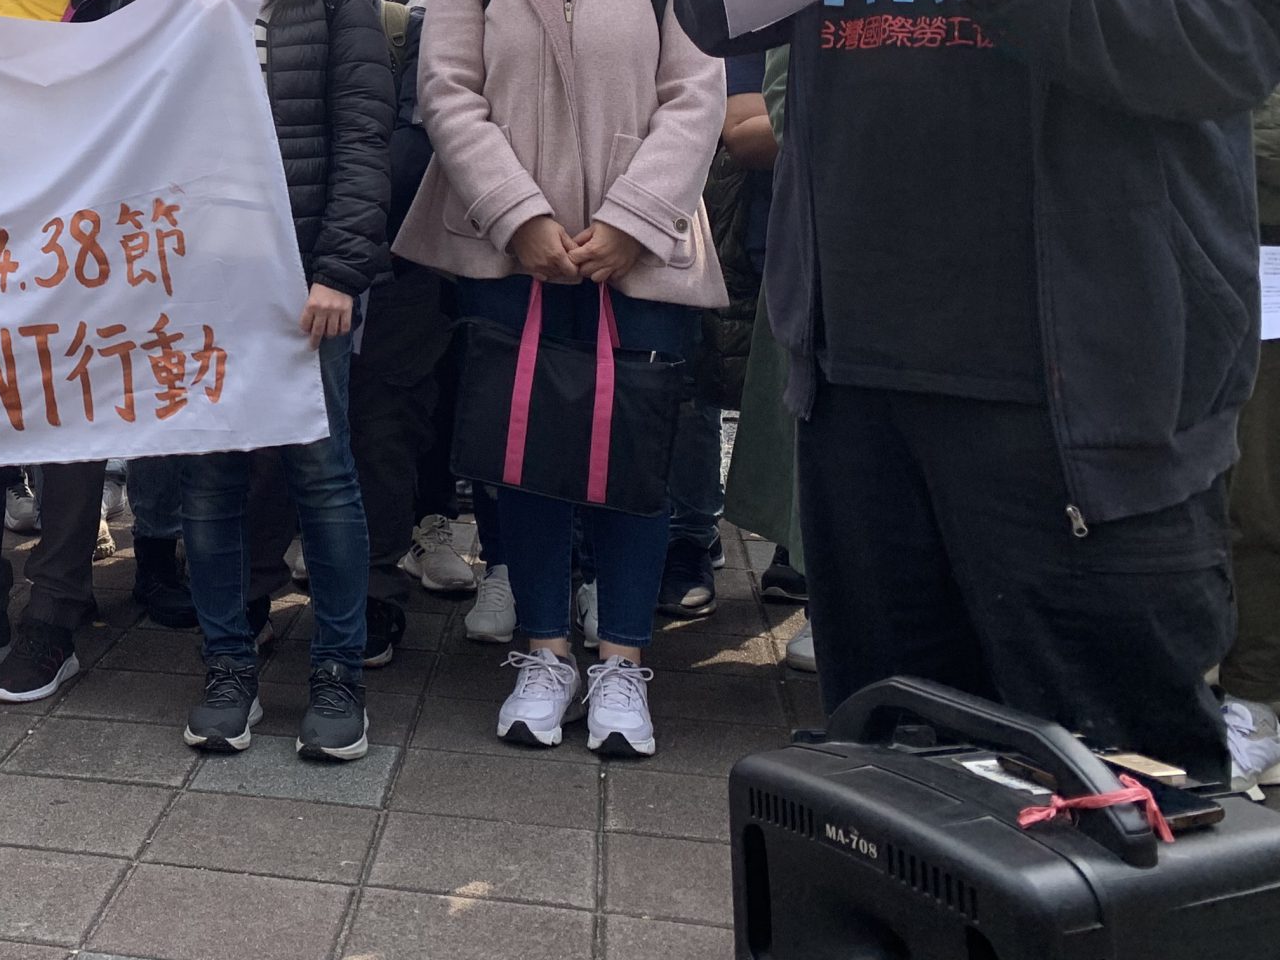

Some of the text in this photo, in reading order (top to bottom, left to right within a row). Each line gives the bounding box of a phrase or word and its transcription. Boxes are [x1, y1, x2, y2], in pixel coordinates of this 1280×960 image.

[821, 14, 994, 50] 台灣國際勞工
[825, 823, 878, 859] MA-708
